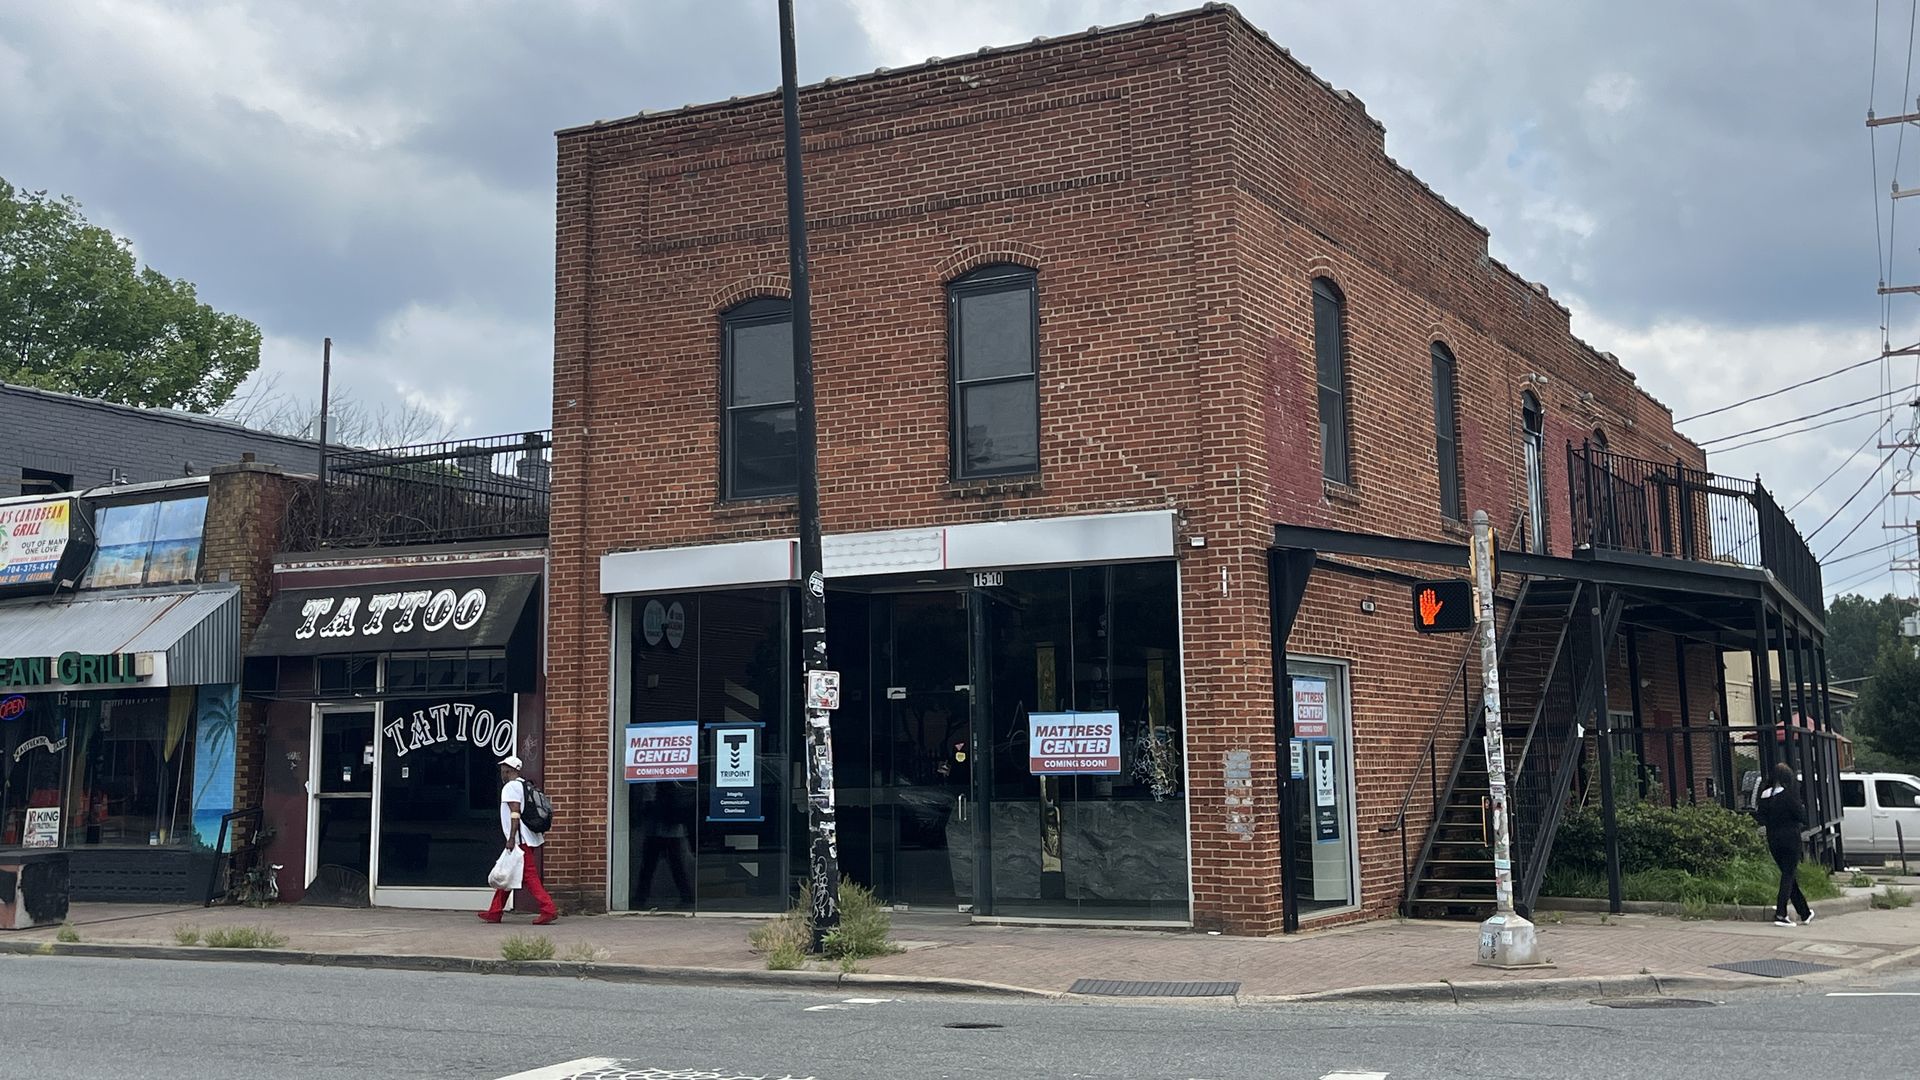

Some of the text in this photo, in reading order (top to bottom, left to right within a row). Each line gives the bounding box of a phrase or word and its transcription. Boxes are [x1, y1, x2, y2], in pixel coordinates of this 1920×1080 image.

[15, 505, 64, 523] CARIBBEAN
[13, 522, 41, 537] GRILL
[21, 537, 67, 549] OUT OF MANY
[41, 545, 58, 554] LOVE
[7, 561, 57, 574] 704-375-8414
[975, 572, 1002, 586] 1510
[295, 588, 487, 640] TATTOO
[57, 651, 138, 685] GRILL
[0, 698, 26, 718] OPEN
[1298, 705, 1323, 719] CENTER
[384, 703, 514, 757] TATTOO
[1035, 724, 1113, 737] MATTRESS
[630, 736, 693, 748] MATTRESS
[1042, 739, 1108, 754] CENTER
[636, 749, 689, 763] CENTER
[1044, 759, 1107, 768] COMING SOON!
[636, 767, 688, 776] COMING SOON!
[37, 811, 59, 822] KING
